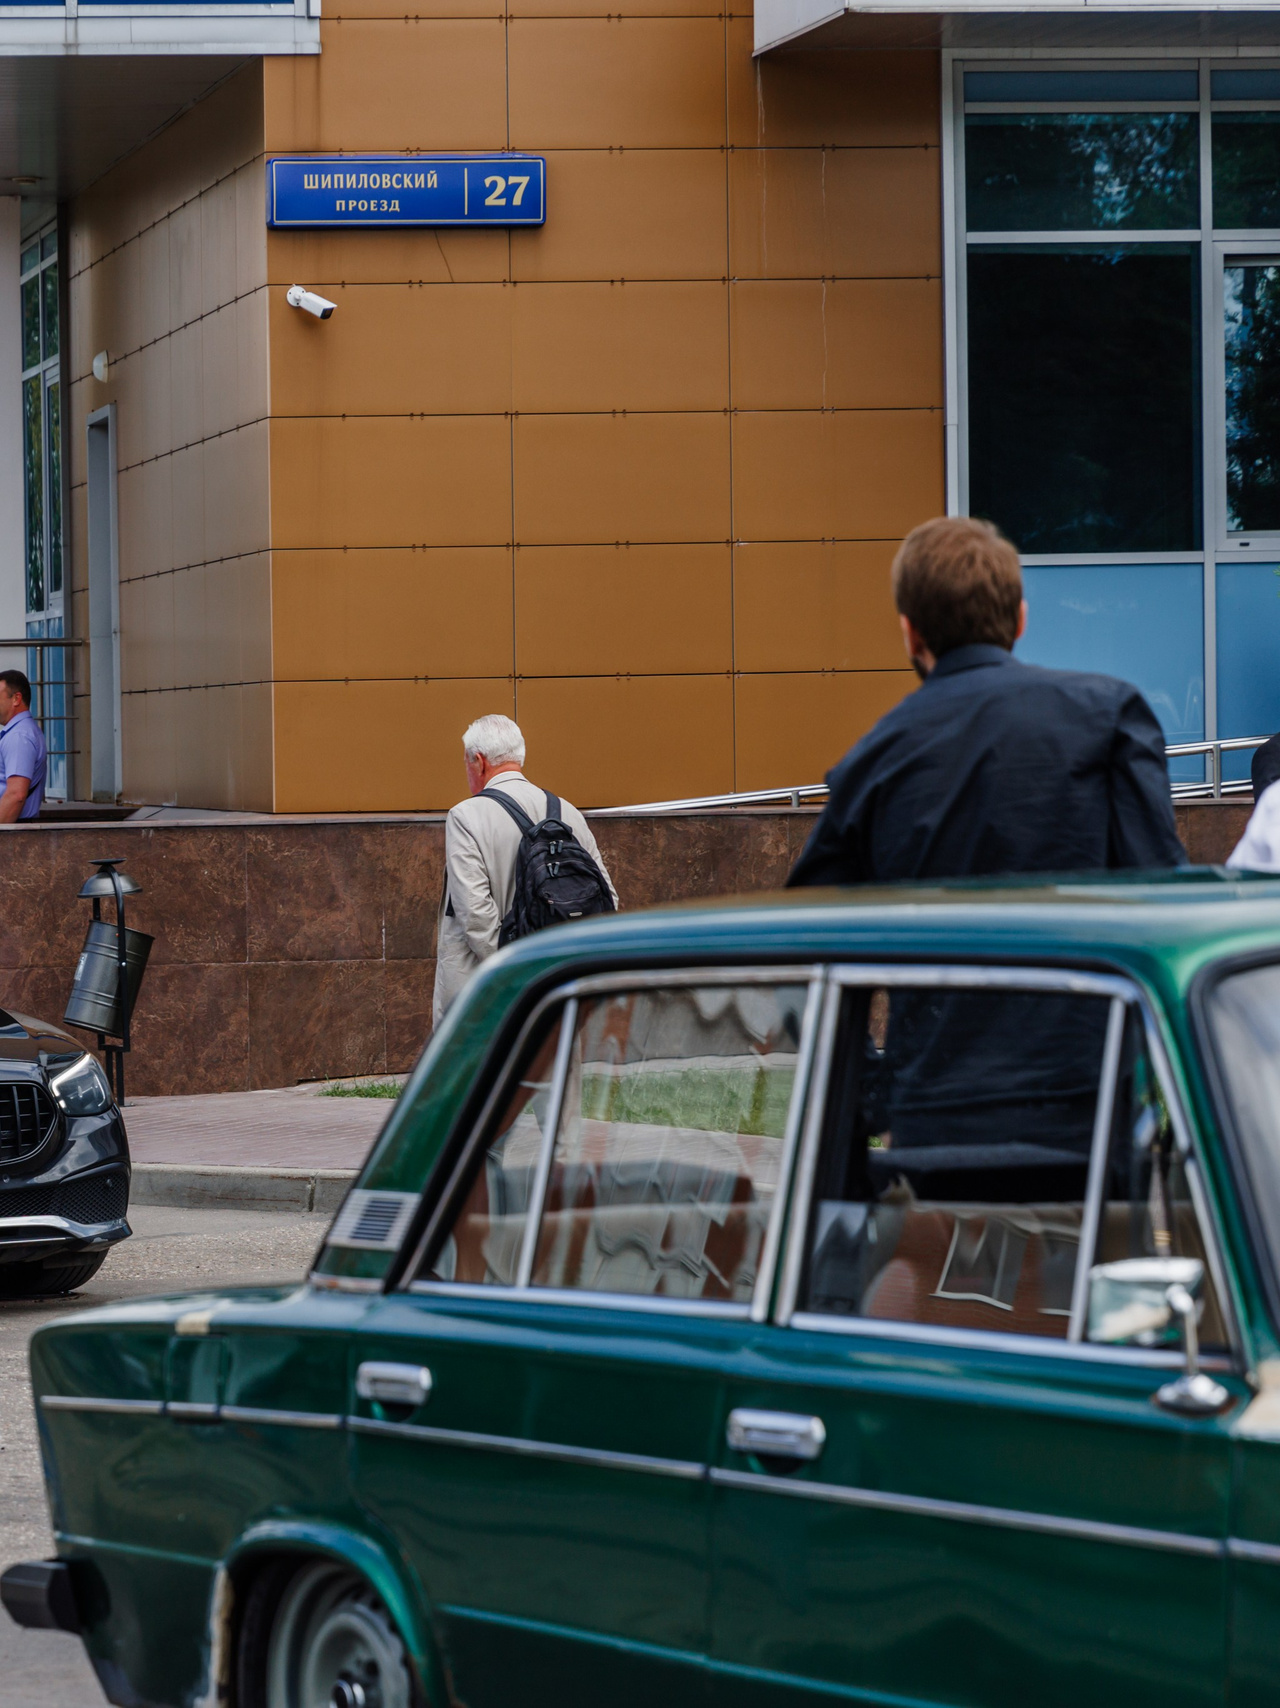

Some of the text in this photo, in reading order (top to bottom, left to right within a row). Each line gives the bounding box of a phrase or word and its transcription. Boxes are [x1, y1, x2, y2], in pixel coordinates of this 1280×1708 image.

[303, 170, 438, 190] ШИПИЛОВСКИЙ
[483, 175, 531, 206] 27
[335, 200, 401, 212] ПРОЕЗД
